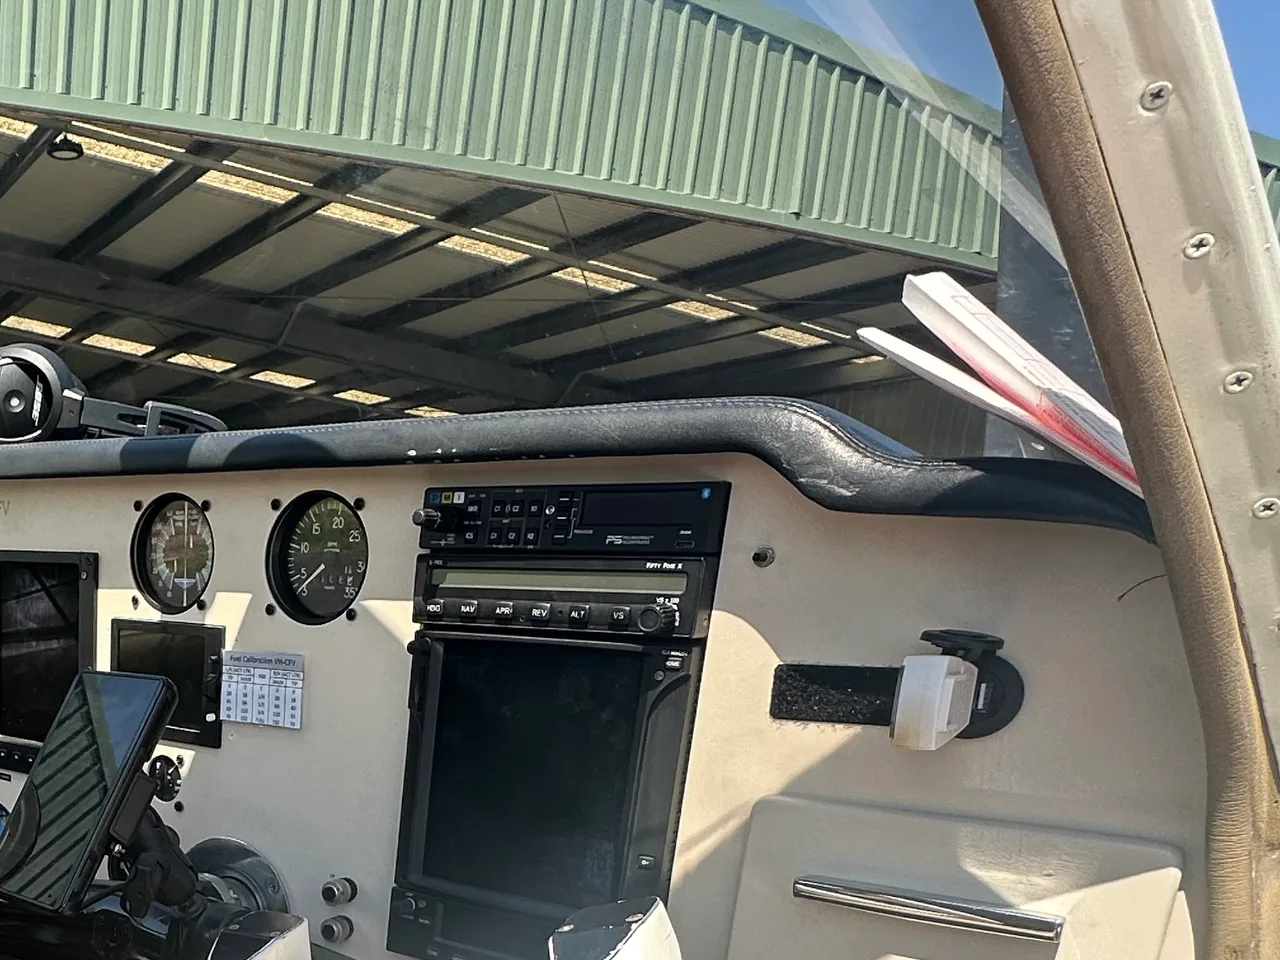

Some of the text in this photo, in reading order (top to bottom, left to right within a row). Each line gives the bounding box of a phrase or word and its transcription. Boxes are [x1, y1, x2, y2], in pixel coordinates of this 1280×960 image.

[332, 516, 345, 529] 20
[313, 524, 321, 535] 15
[349, 530, 360, 543] 25
[300, 542, 310, 553] 10
[300, 568, 307, 578] 5
[343, 587, 357, 598] 35
[426, 604, 441, 613] HDG
[460, 605, 477, 613] NAV
[495, 606, 511, 615] APR
[531, 608, 548, 617] REV
[570, 611, 585, 619] ALT
[613, 611, 624, 620] VS
[242, 655, 273, 664] Calibration
[274, 658, 297, 667] VH-CFV
